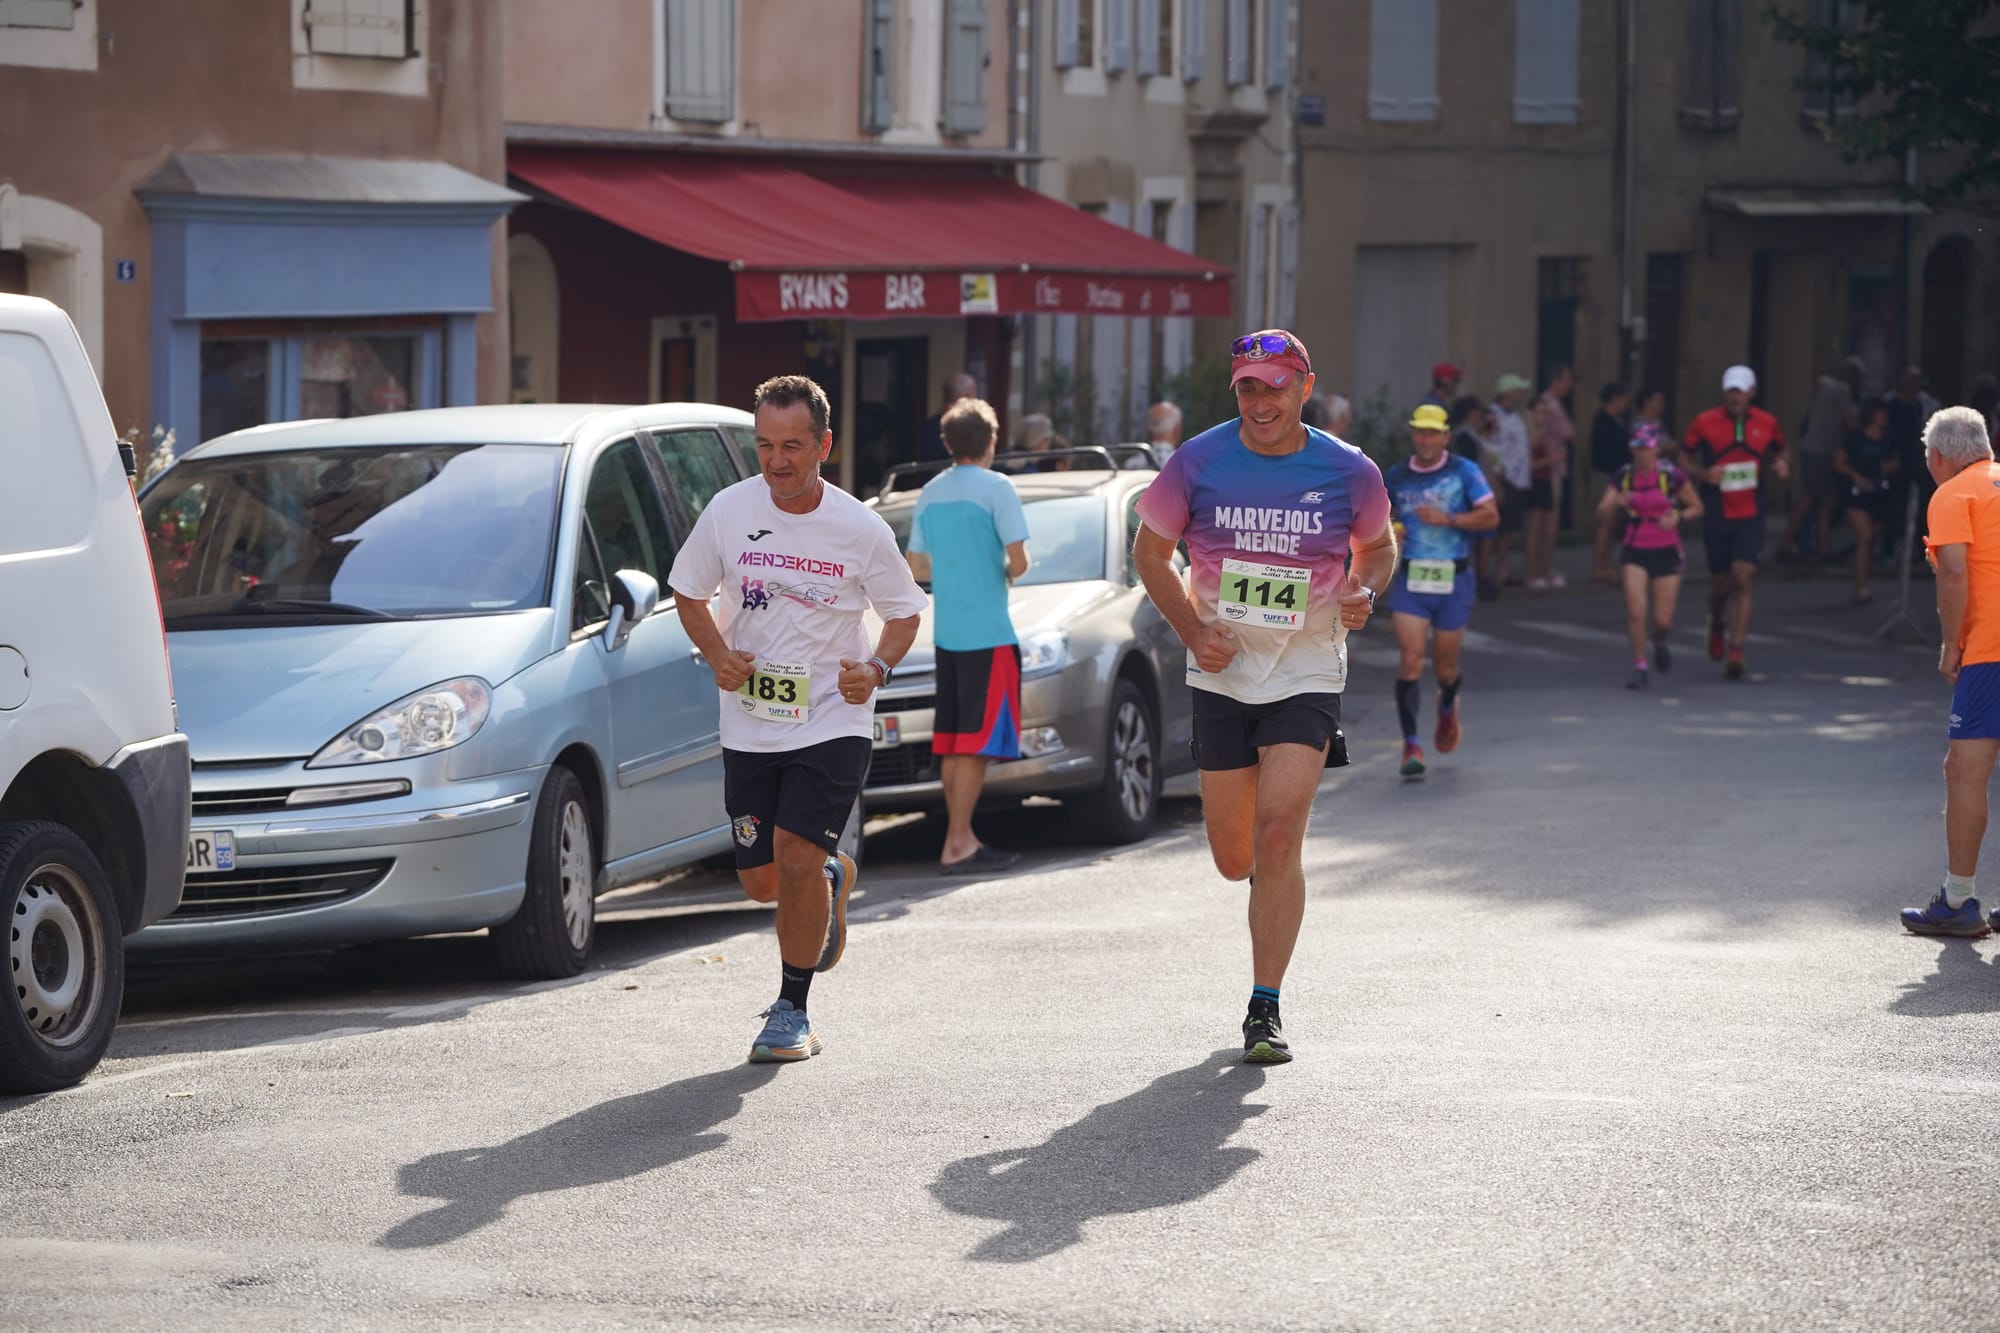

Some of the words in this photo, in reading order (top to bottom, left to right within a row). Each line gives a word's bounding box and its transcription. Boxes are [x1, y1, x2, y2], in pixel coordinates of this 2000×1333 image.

[779, 273, 849, 311] RYAN'S
[885, 273, 925, 310] BAR
[1214, 506, 1323, 535] MARVEJOLS
[1234, 531, 1301, 555] MENDE
[737, 551, 844, 578] MENDEKIDEN
[1419, 567, 1442, 582] 75
[1233, 577, 1296, 609] 114
[748, 673, 797, 703] 183
[216, 850, 232, 865] 59
